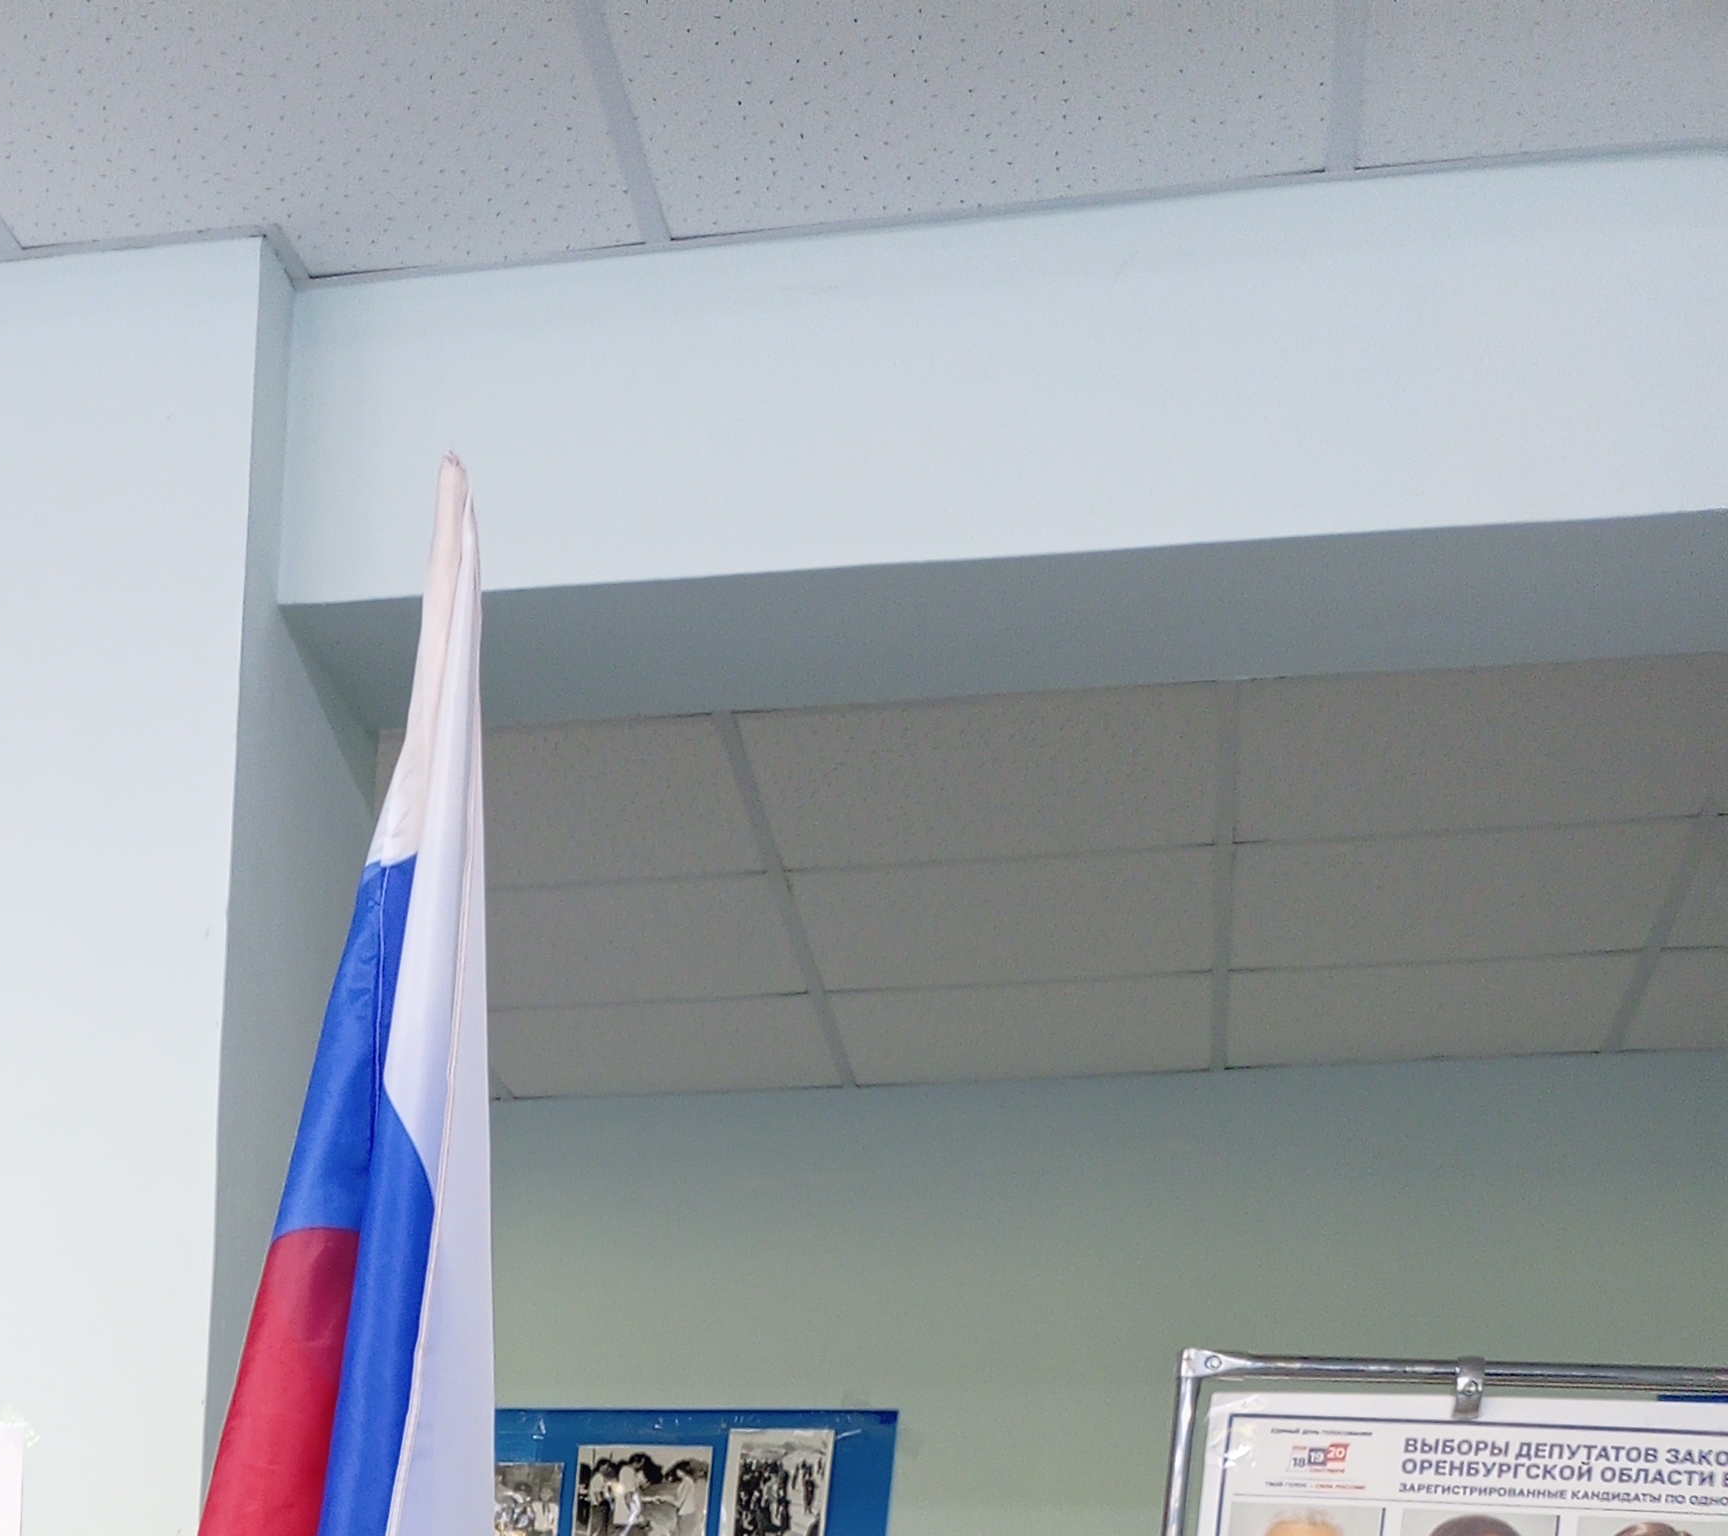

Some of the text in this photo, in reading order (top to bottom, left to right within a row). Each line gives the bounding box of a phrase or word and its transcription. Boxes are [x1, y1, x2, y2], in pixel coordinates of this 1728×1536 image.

[1310, 1450, 1324, 1463] 19
[1326, 1447, 1346, 1459] 20
[1403, 1437, 1728, 1467] ВЫБОРЫ ДЕПУТАТОВ ЗАКО
[1401, 1457, 1593, 1482] ОРЕНБУРГСКОЙ
[1599, 1465, 1715, 1488] ОБЛАСТИ
[1399, 1482, 1568, 1500] ЗАРЕГИСТРИРОВАННЫЕ
[1570, 1489, 1661, 1504] КАНДИДАТЫ
[1665, 1493, 1686, 1505] ПО
